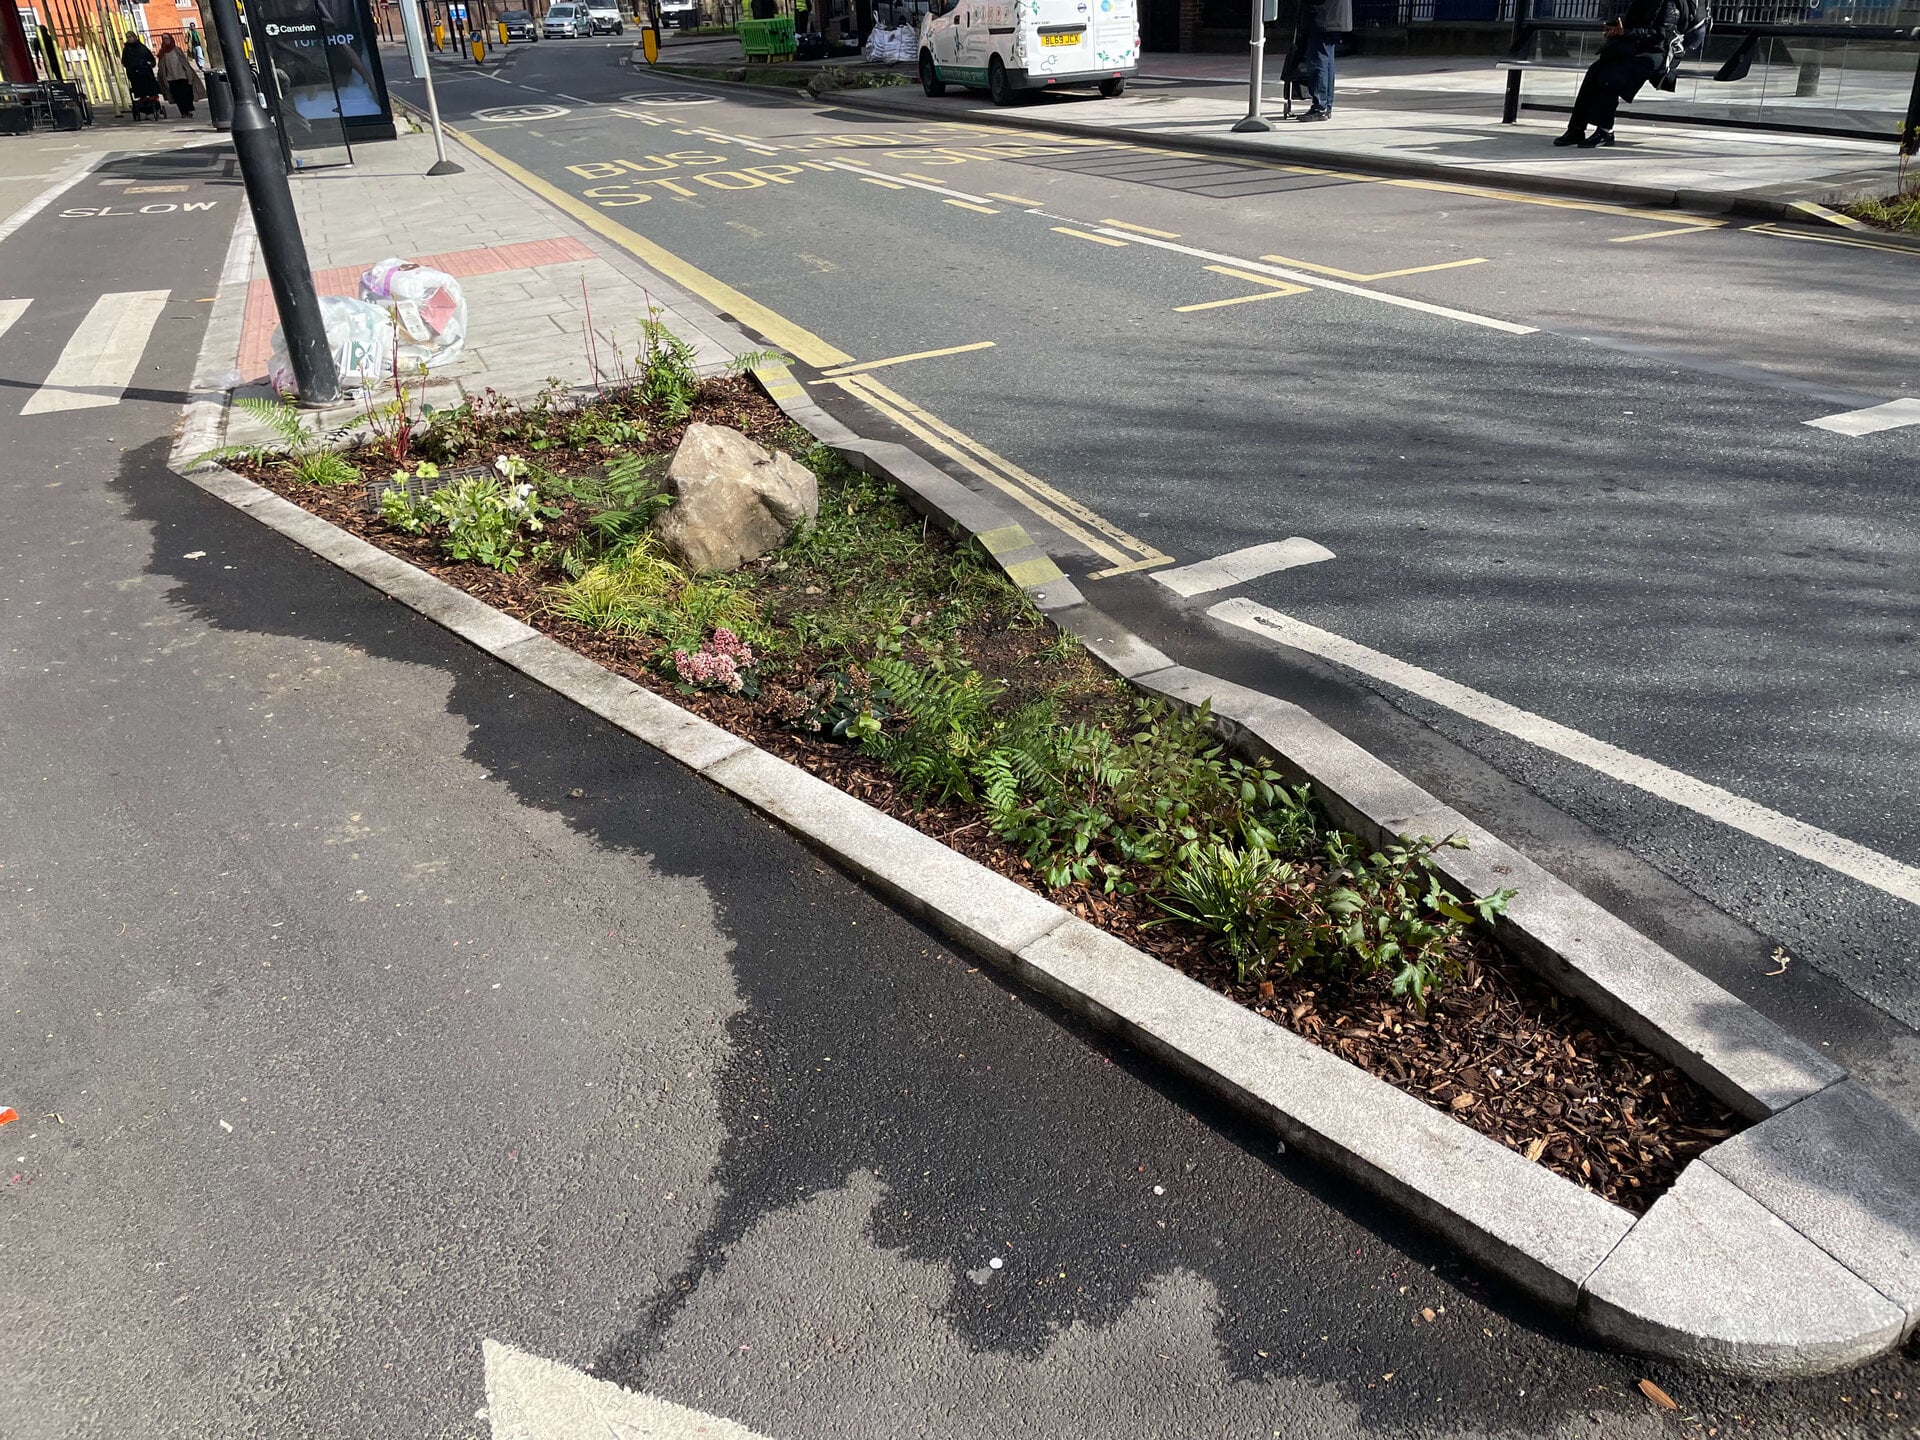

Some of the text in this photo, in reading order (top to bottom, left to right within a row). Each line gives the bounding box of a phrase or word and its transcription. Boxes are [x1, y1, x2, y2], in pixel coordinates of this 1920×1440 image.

[280, 24, 316, 33] Camden
[293, 34, 354, 48] TOPHOP
[483, 107, 556, 119] 20
[805, 128, 990, 149] STOP
[882, 142, 1077, 166] BUS
[564, 150, 728, 180] BUS
[582, 164, 804, 207] STOP
[58, 201, 218, 218] SLOW
